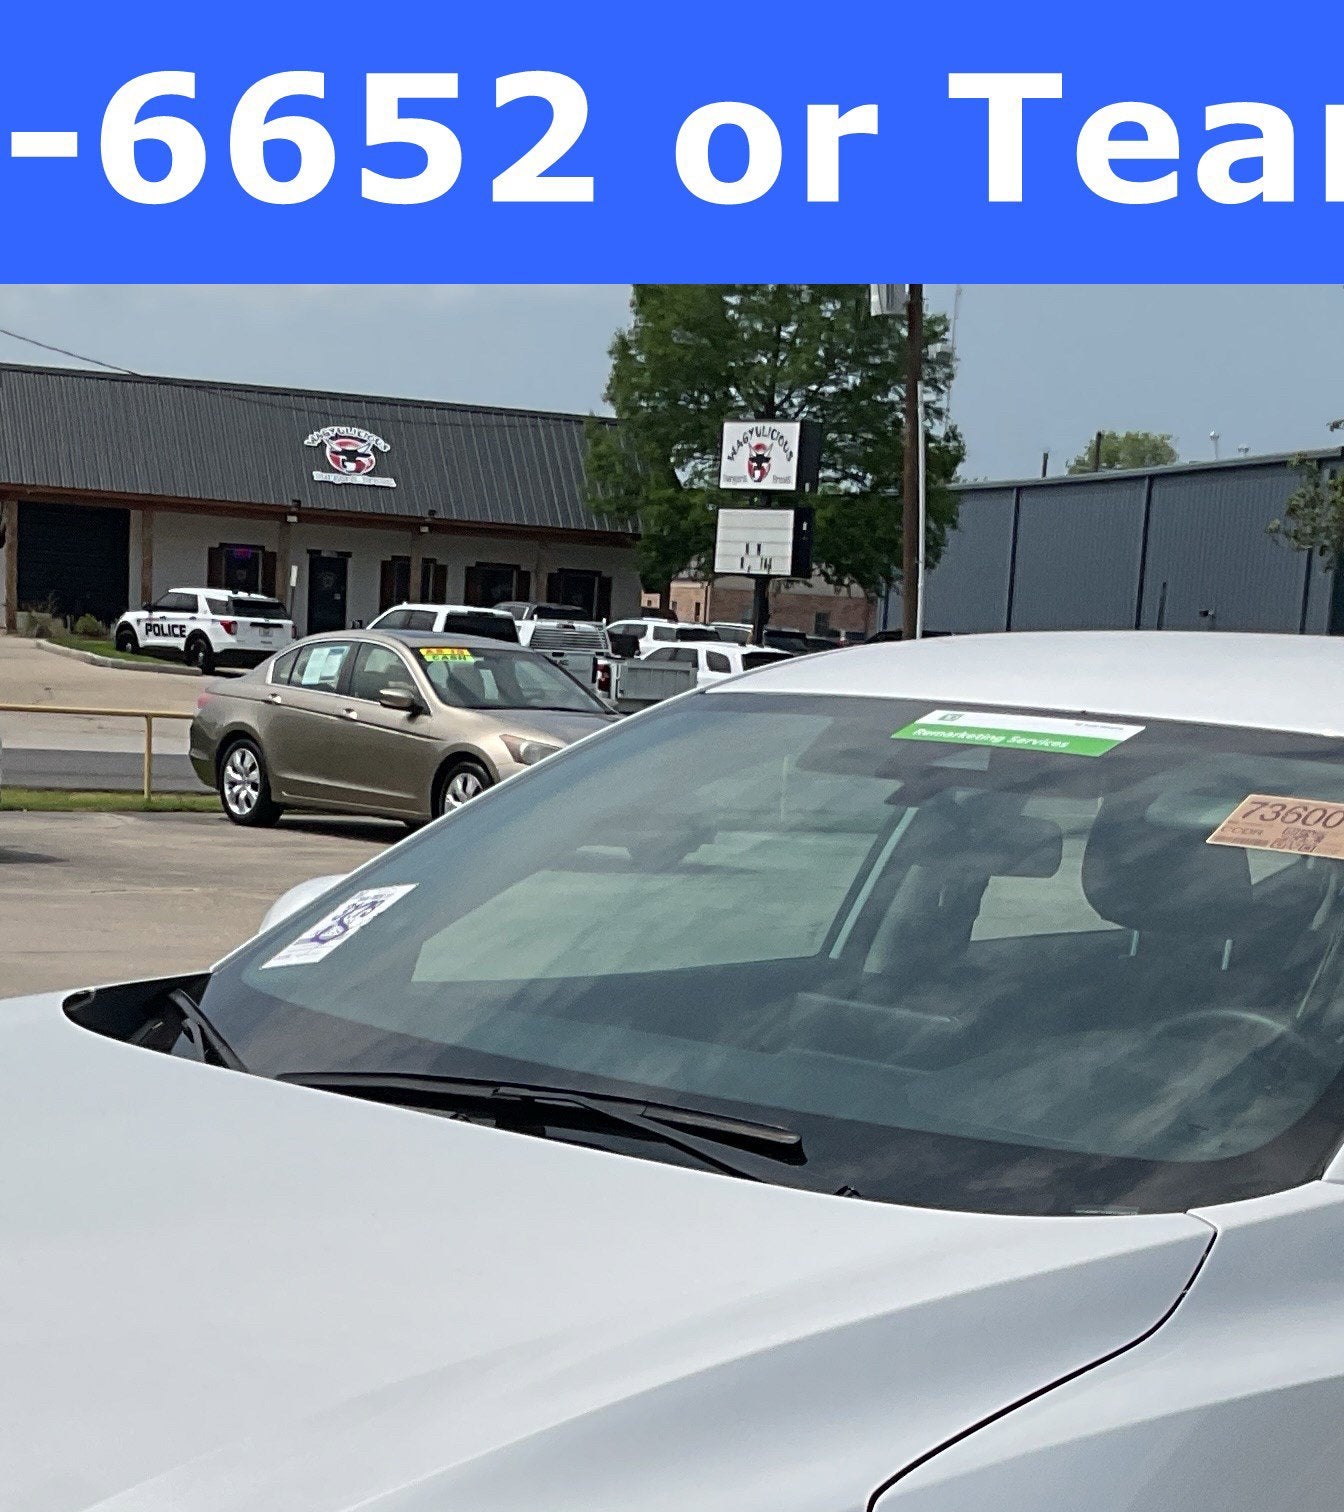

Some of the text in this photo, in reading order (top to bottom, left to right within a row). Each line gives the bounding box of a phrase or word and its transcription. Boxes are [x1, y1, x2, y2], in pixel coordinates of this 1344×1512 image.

[727, 425, 794, 462] WAGYULICIOUS
[145, 622, 187, 638] POLICE
[912, 728, 1071, 749] Remarketing Services
